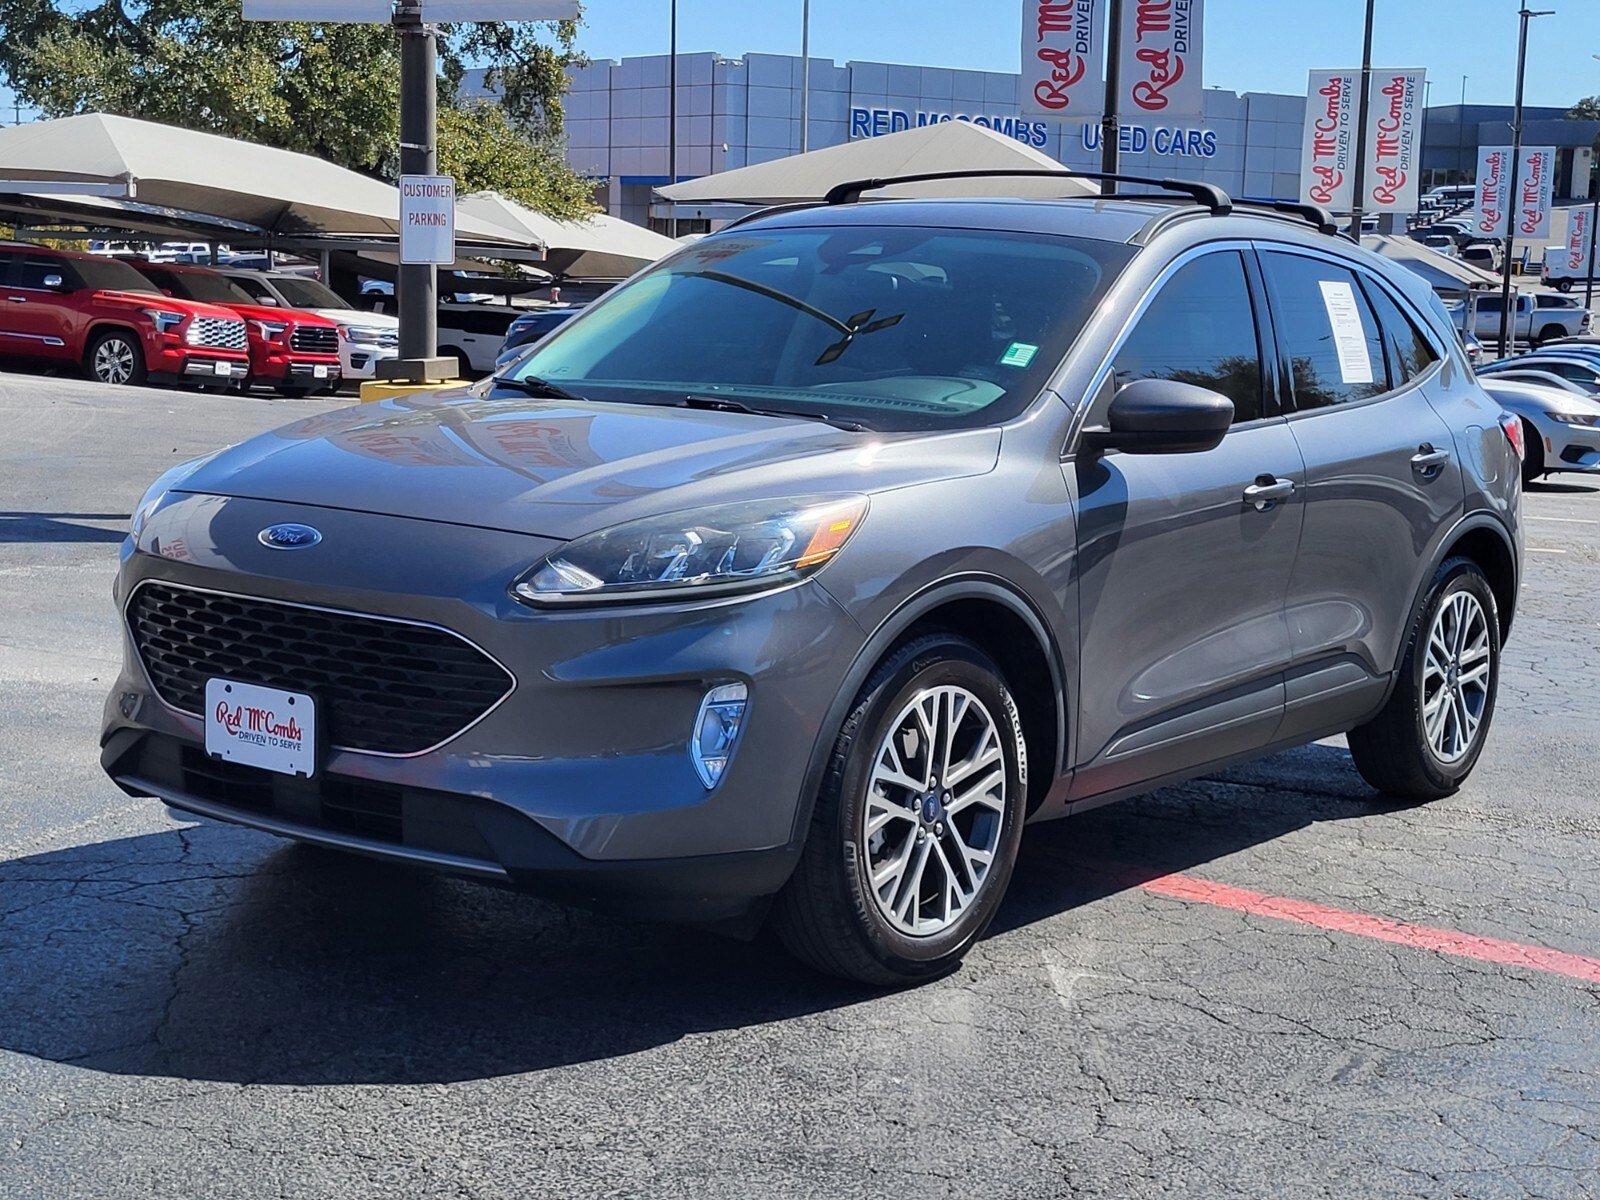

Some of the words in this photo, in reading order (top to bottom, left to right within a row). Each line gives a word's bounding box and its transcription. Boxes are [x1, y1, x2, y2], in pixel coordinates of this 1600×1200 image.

[1076, 0, 1090, 53] DRIVE
[1174, 0, 1188, 53] DRIVE
[1034, 48, 1085, 109] Red
[1133, 48, 1183, 110] Red
[1341, 77, 1352, 110] SERVE
[1405, 76, 1415, 109] SERVE
[851, 107, 909, 137] RED
[1312, 77, 1342, 163] McCombs
[1340, 112, 1349, 127] TO
[1375, 76, 1405, 163] McCombs
[1403, 112, 1412, 127] TO
[1154, 128, 1216, 156] CARS
[1337, 130, 1348, 170] DRIVEN
[1400, 130, 1411, 170] DRIVEN
[403, 183, 451, 198] CUSTOMER
[1309, 166, 1343, 203] Red
[1373, 166, 1406, 204] Red
[1482, 151, 1500, 206] McCombs
[1499, 174, 1506, 183] TO
[1523, 152, 1542, 206] McCombs
[1540, 174, 1547, 184] TO
[408, 212, 447, 226] PARKING
[1479, 208, 1501, 232] Red
[1520, 208, 1542, 233] Red
[216, 701, 242, 735] Red
[244, 707, 301, 741] McCombs
[239, 731, 266, 744] DRIVEN
[268, 737, 278, 746] TO
[280, 739, 301, 751] SERVE
